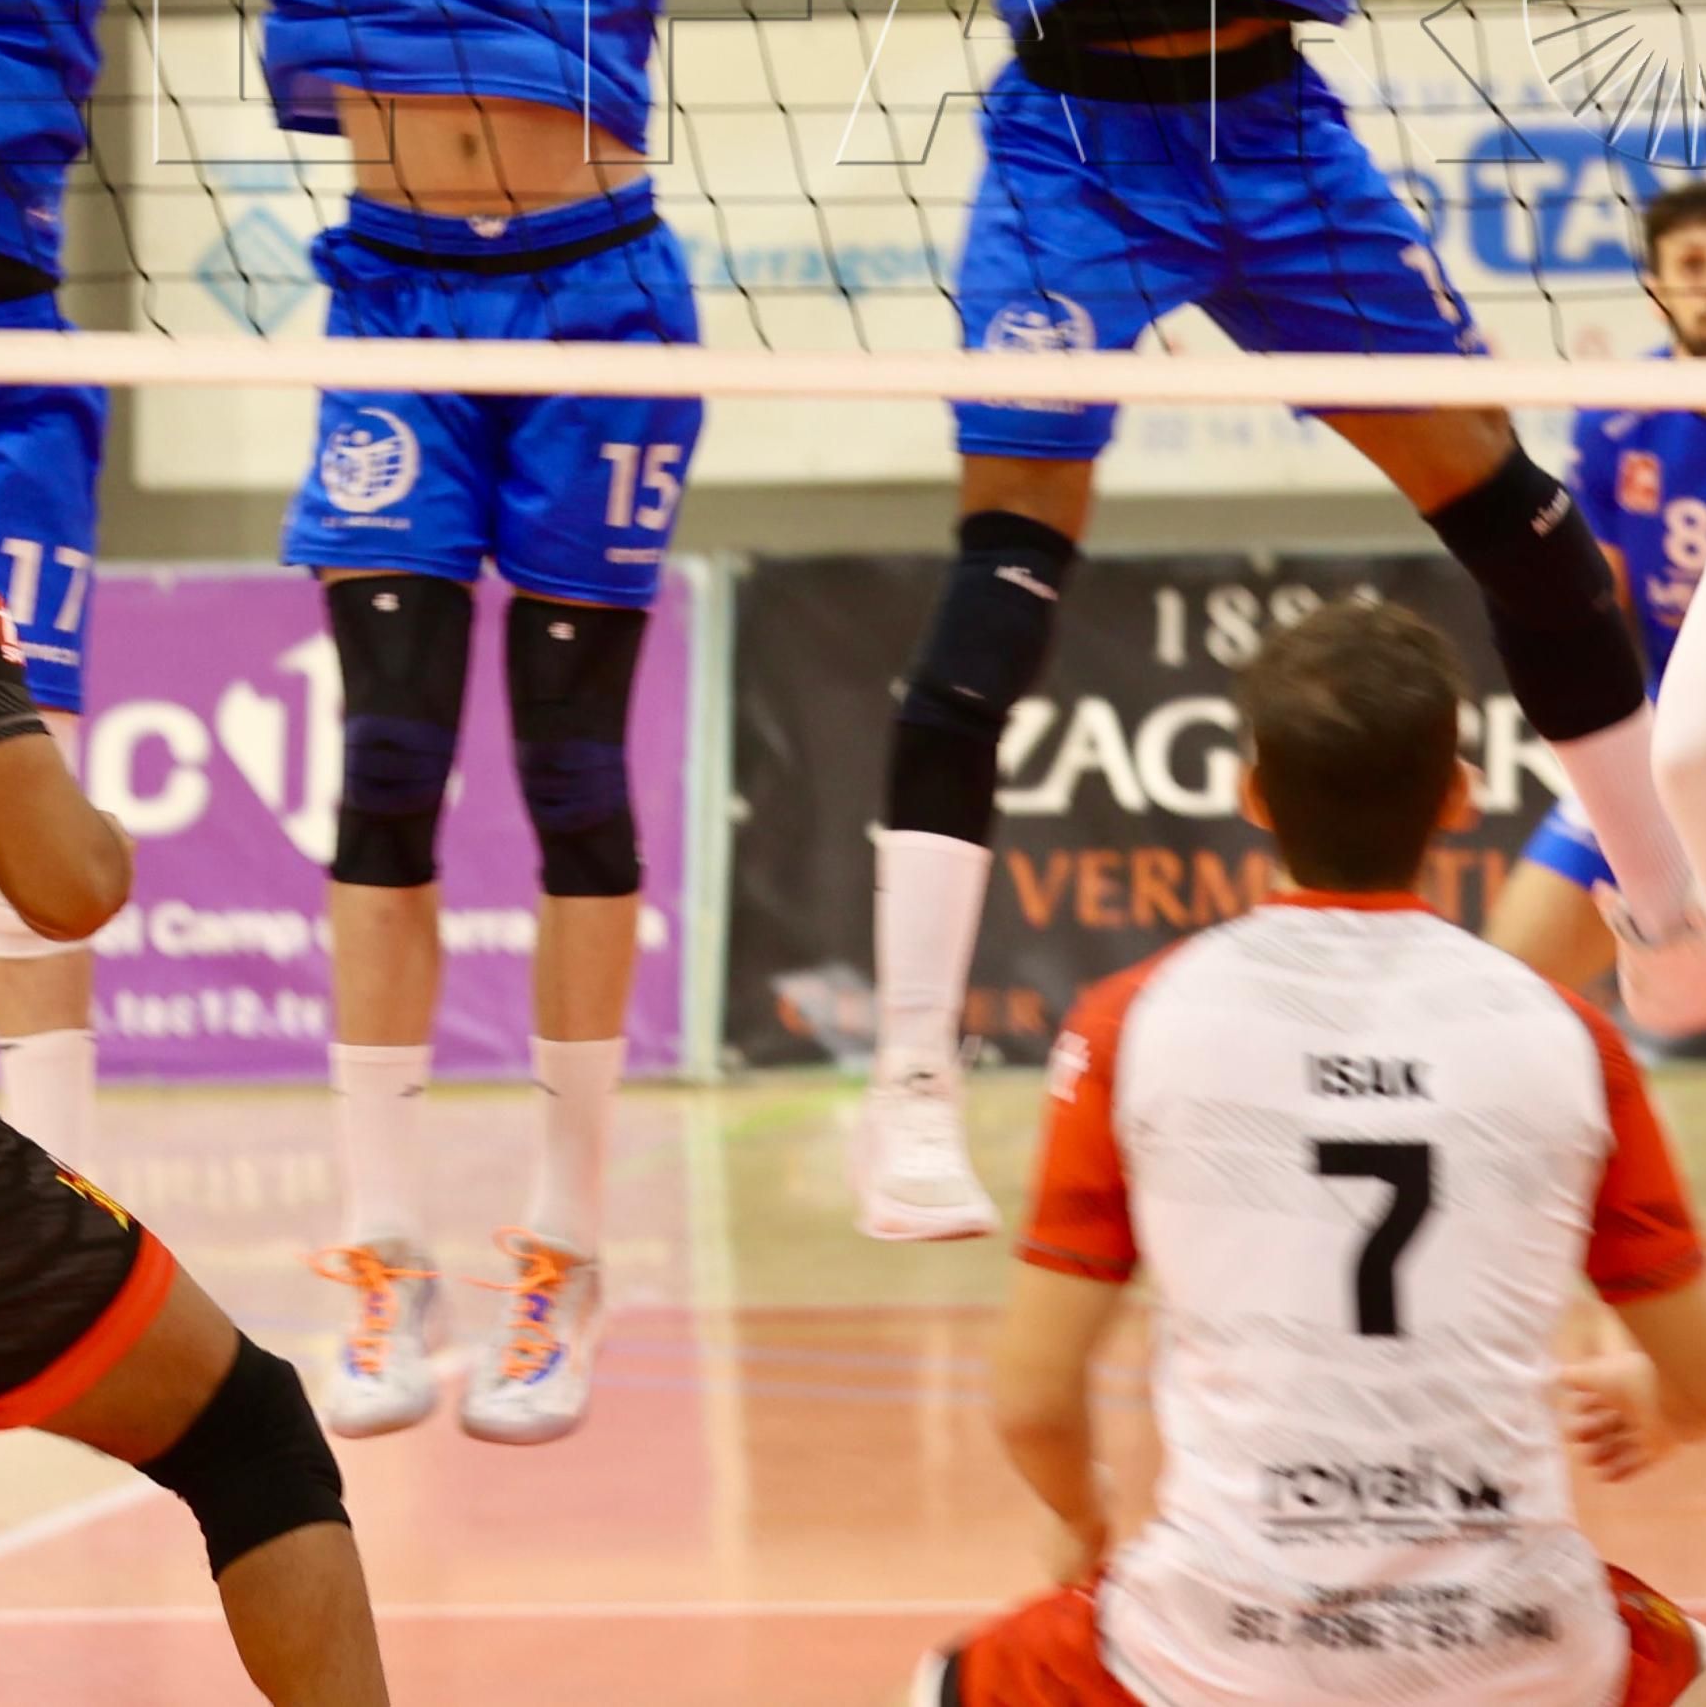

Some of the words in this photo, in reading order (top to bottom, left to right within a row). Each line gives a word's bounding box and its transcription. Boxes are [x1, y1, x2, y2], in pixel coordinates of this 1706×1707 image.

[600, 442, 683, 531] 15
[0, 536, 94, 633] 17
[1306, 1135, 1436, 1339] 7
